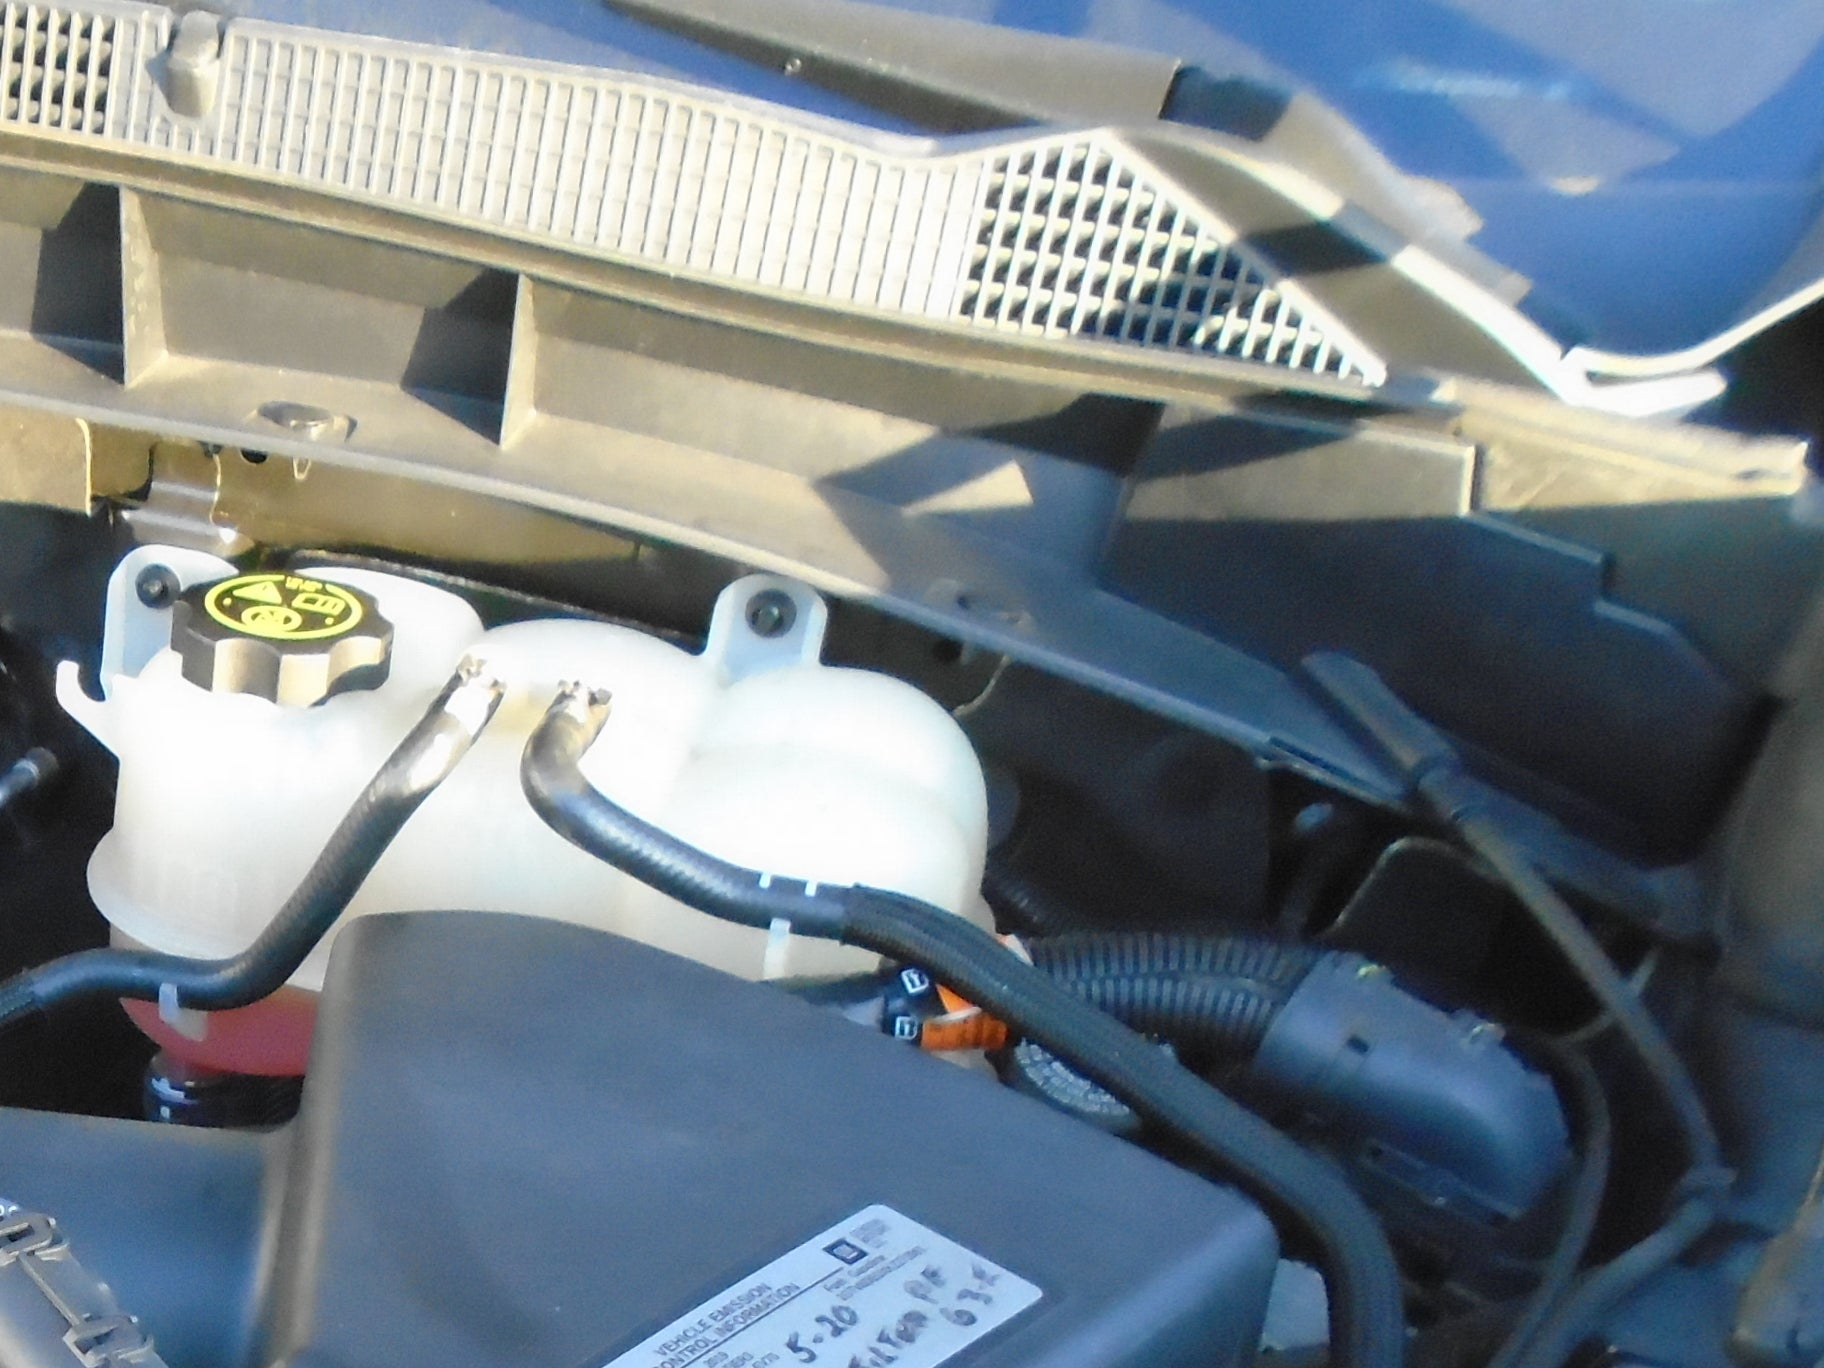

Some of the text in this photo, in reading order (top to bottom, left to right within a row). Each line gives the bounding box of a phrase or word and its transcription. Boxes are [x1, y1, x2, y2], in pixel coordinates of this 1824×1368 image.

[654, 1283, 771, 1355] VEHICLE EMISSION
[714, 1283, 800, 1336] INFORMATION
